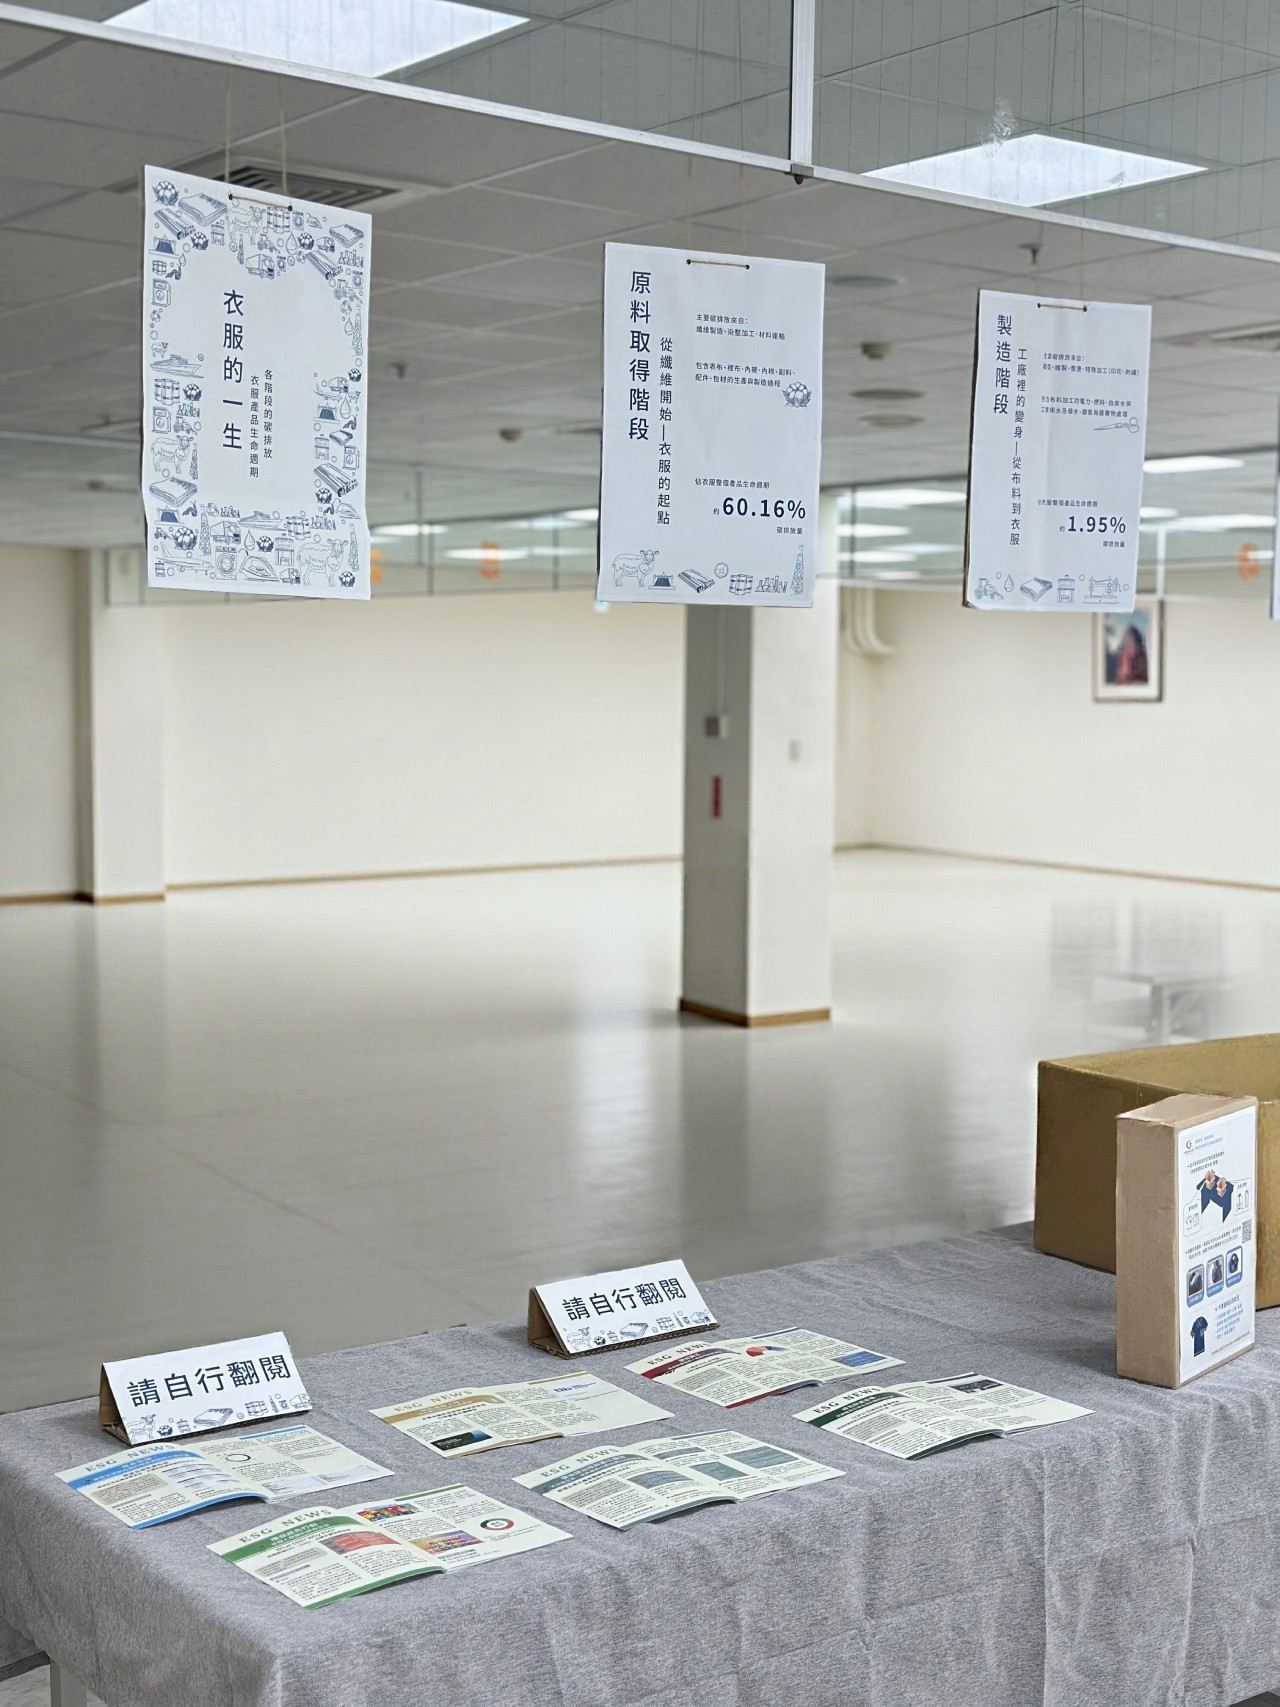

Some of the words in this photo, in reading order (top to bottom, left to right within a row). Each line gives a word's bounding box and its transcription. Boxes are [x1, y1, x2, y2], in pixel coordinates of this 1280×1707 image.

[222, 288, 245, 450] 衣服的一生
[628, 270, 652, 441] 原料取得階段
[992, 313, 1013, 415] 製造階段
[249, 374, 260, 478] 衣服產品生命週期
[263, 368, 274, 459] 各階段的碳排放
[723, 496, 807, 520] 60.16%
[776, 526, 803, 535] 碳排放量
[1067, 515, 1127, 534] 1.95%
[561, 1277, 687, 1321] 請自行翻閱
[647, 1354, 673, 1366] ESG
[126, 1354, 292, 1408] 請自行翻閱
[394, 1402, 423, 1412] ESG
[430, 1390, 473, 1403] NEWS
[813, 1401, 840, 1414] ESG
[843, 1387, 881, 1401] NEWS
[85, 1458, 117, 1472] ESG
[127, 1444, 175, 1459] NEWS
[541, 1464, 570, 1478] ESG
[576, 1447, 620, 1464] NEWS
[239, 1528, 273, 1543] ESG
[281, 1509, 332, 1527] NEWS
